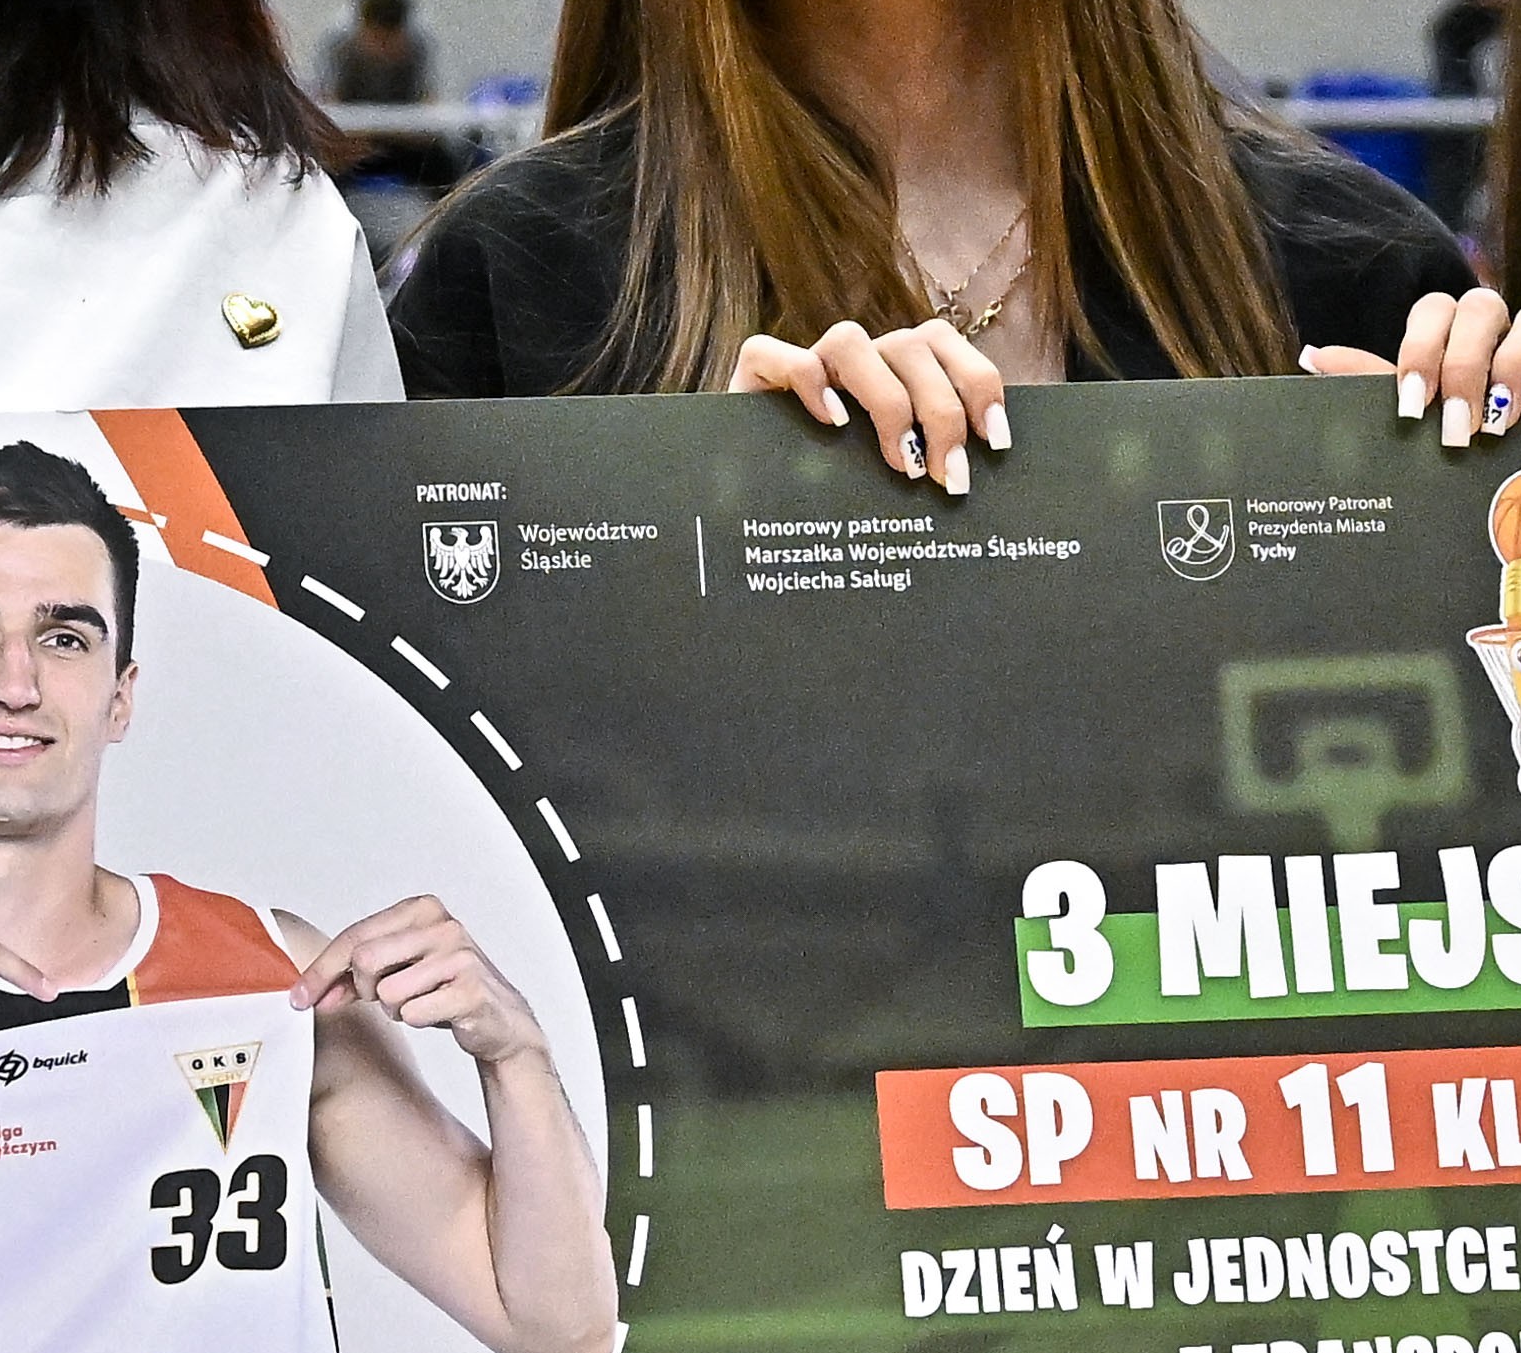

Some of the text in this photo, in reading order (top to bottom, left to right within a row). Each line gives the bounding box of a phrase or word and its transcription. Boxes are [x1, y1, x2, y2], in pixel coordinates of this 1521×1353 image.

[416, 482, 507, 502] PATRONAT:
[1247, 496, 1394, 515] Honorowy Patronat
[518, 521, 658, 546] Województwo
[743, 515, 934, 539] Honorowy patronat
[1248, 517, 1386, 539] Prezydenta Miasta
[521, 547, 593, 574] Śląskie
[745, 534, 1081, 565] Marszałka Województwa Śląskiego
[1250, 542, 1297, 562] Tychy
[746, 568, 912, 595] Wojciecha Saługi
[1021, 860, 1114, 1006] 3
[32, 1049, 89, 1072] bquick
[191, 1051, 248, 1072] GKS
[949, 1070, 1093, 1191] SP
[1129, 1086, 1252, 1183] NR
[1278, 1060, 1397, 1178] 11
[149, 1153, 289, 1286] 33
[901, 1224, 1079, 1318] DZIEŃ
[1093, 1243, 1155, 1310] W
[1172, 1225, 1520, 1305] JEDNOSTCE
